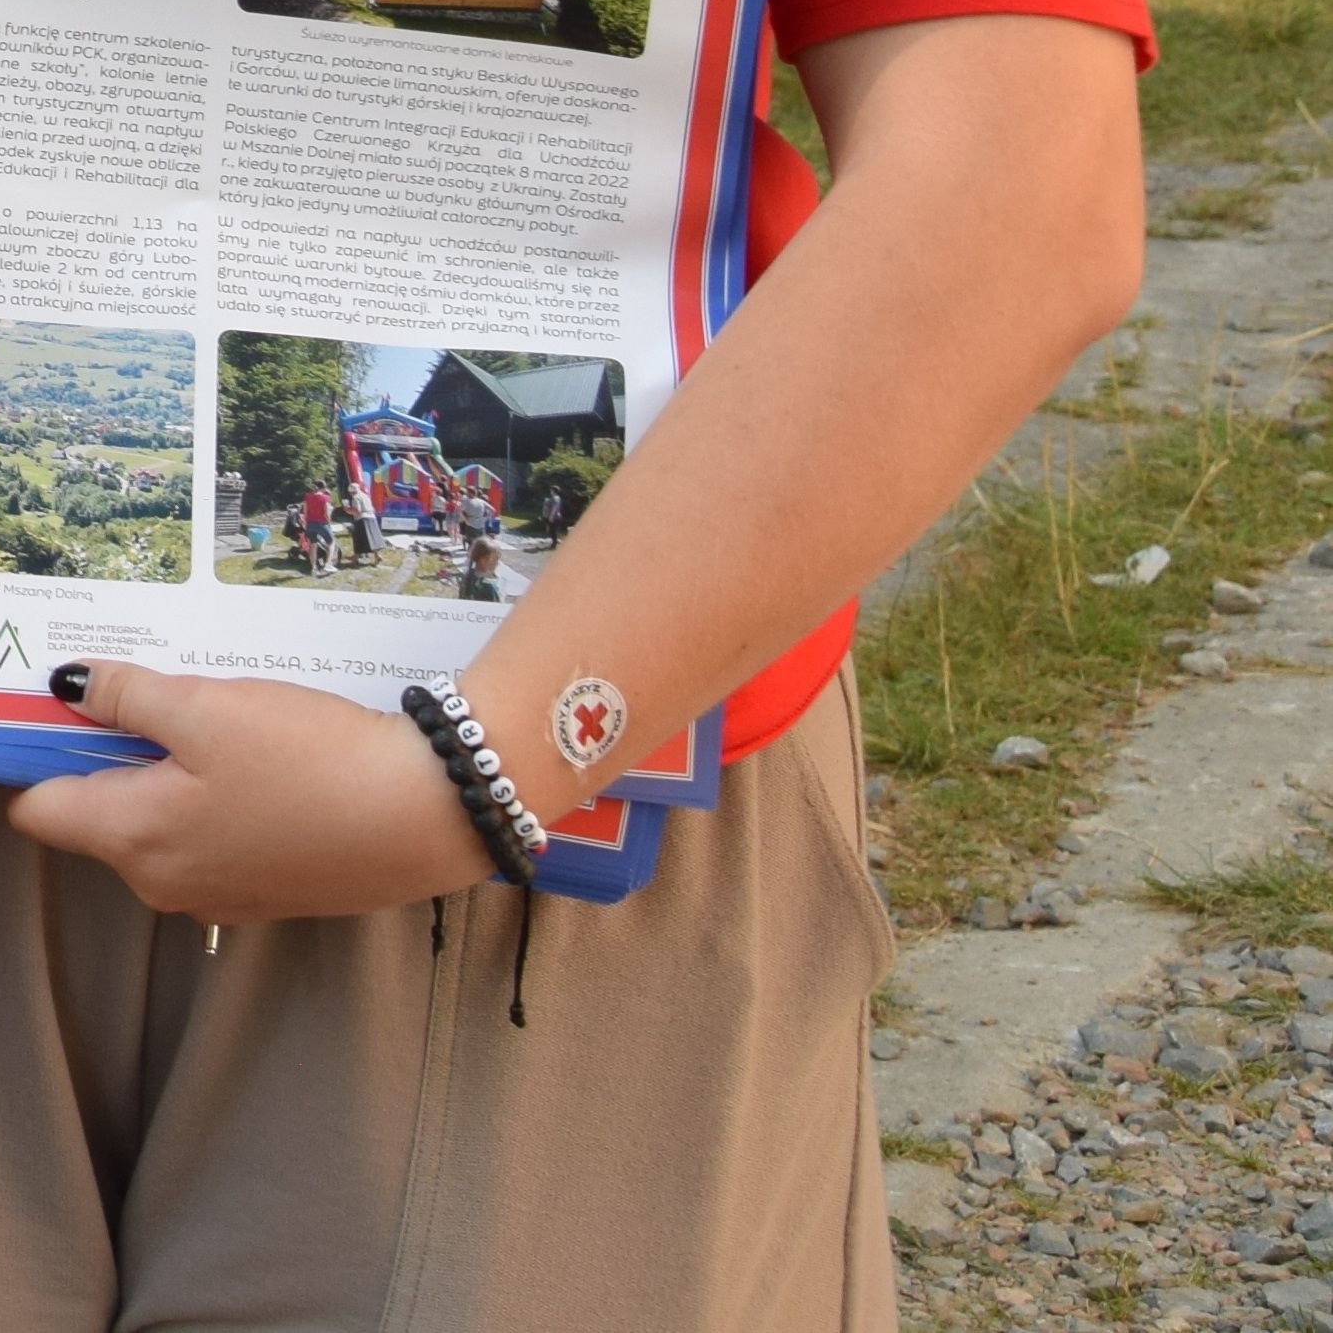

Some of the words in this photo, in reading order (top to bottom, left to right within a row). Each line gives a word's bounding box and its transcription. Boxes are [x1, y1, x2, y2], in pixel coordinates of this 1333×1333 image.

[180, 650, 200, 665] ul.
[205, 651, 260, 668] Leśna
[263, 654, 306, 673] 54A,
[311, 657, 376, 676] 34-739
